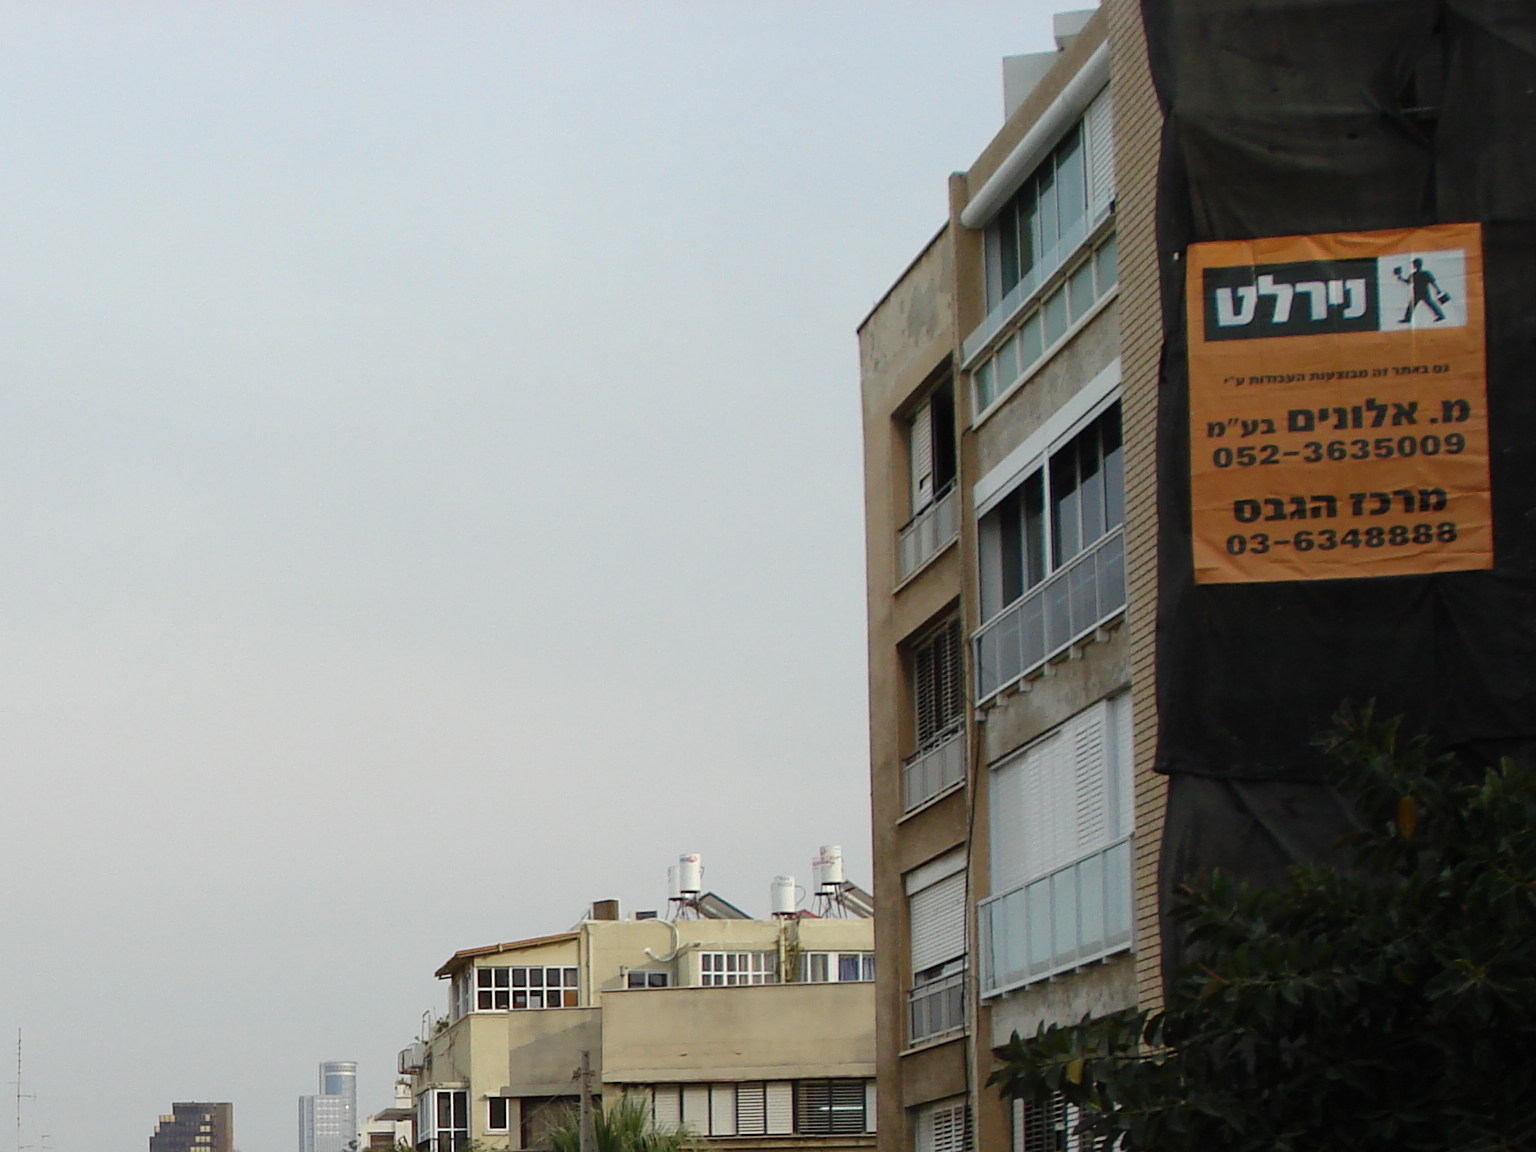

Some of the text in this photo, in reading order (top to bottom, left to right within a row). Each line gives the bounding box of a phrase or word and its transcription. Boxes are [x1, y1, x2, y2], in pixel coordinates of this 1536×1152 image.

[1216, 274, 1368, 327] נירלט
[1248, 373, 1306, 386] העבודות
[1372, 367, 1390, 378] זה
[1392, 364, 1430, 376] באתר
[1432, 363, 1451, 374] גם
[1206, 397, 1473, 439] מ. אלונים בע"מ
[1212, 432, 1467, 469] 052-3635009
[1233, 486, 1448, 524] מרכז הגבס
[1226, 521, 1459, 556] 03-6348888
